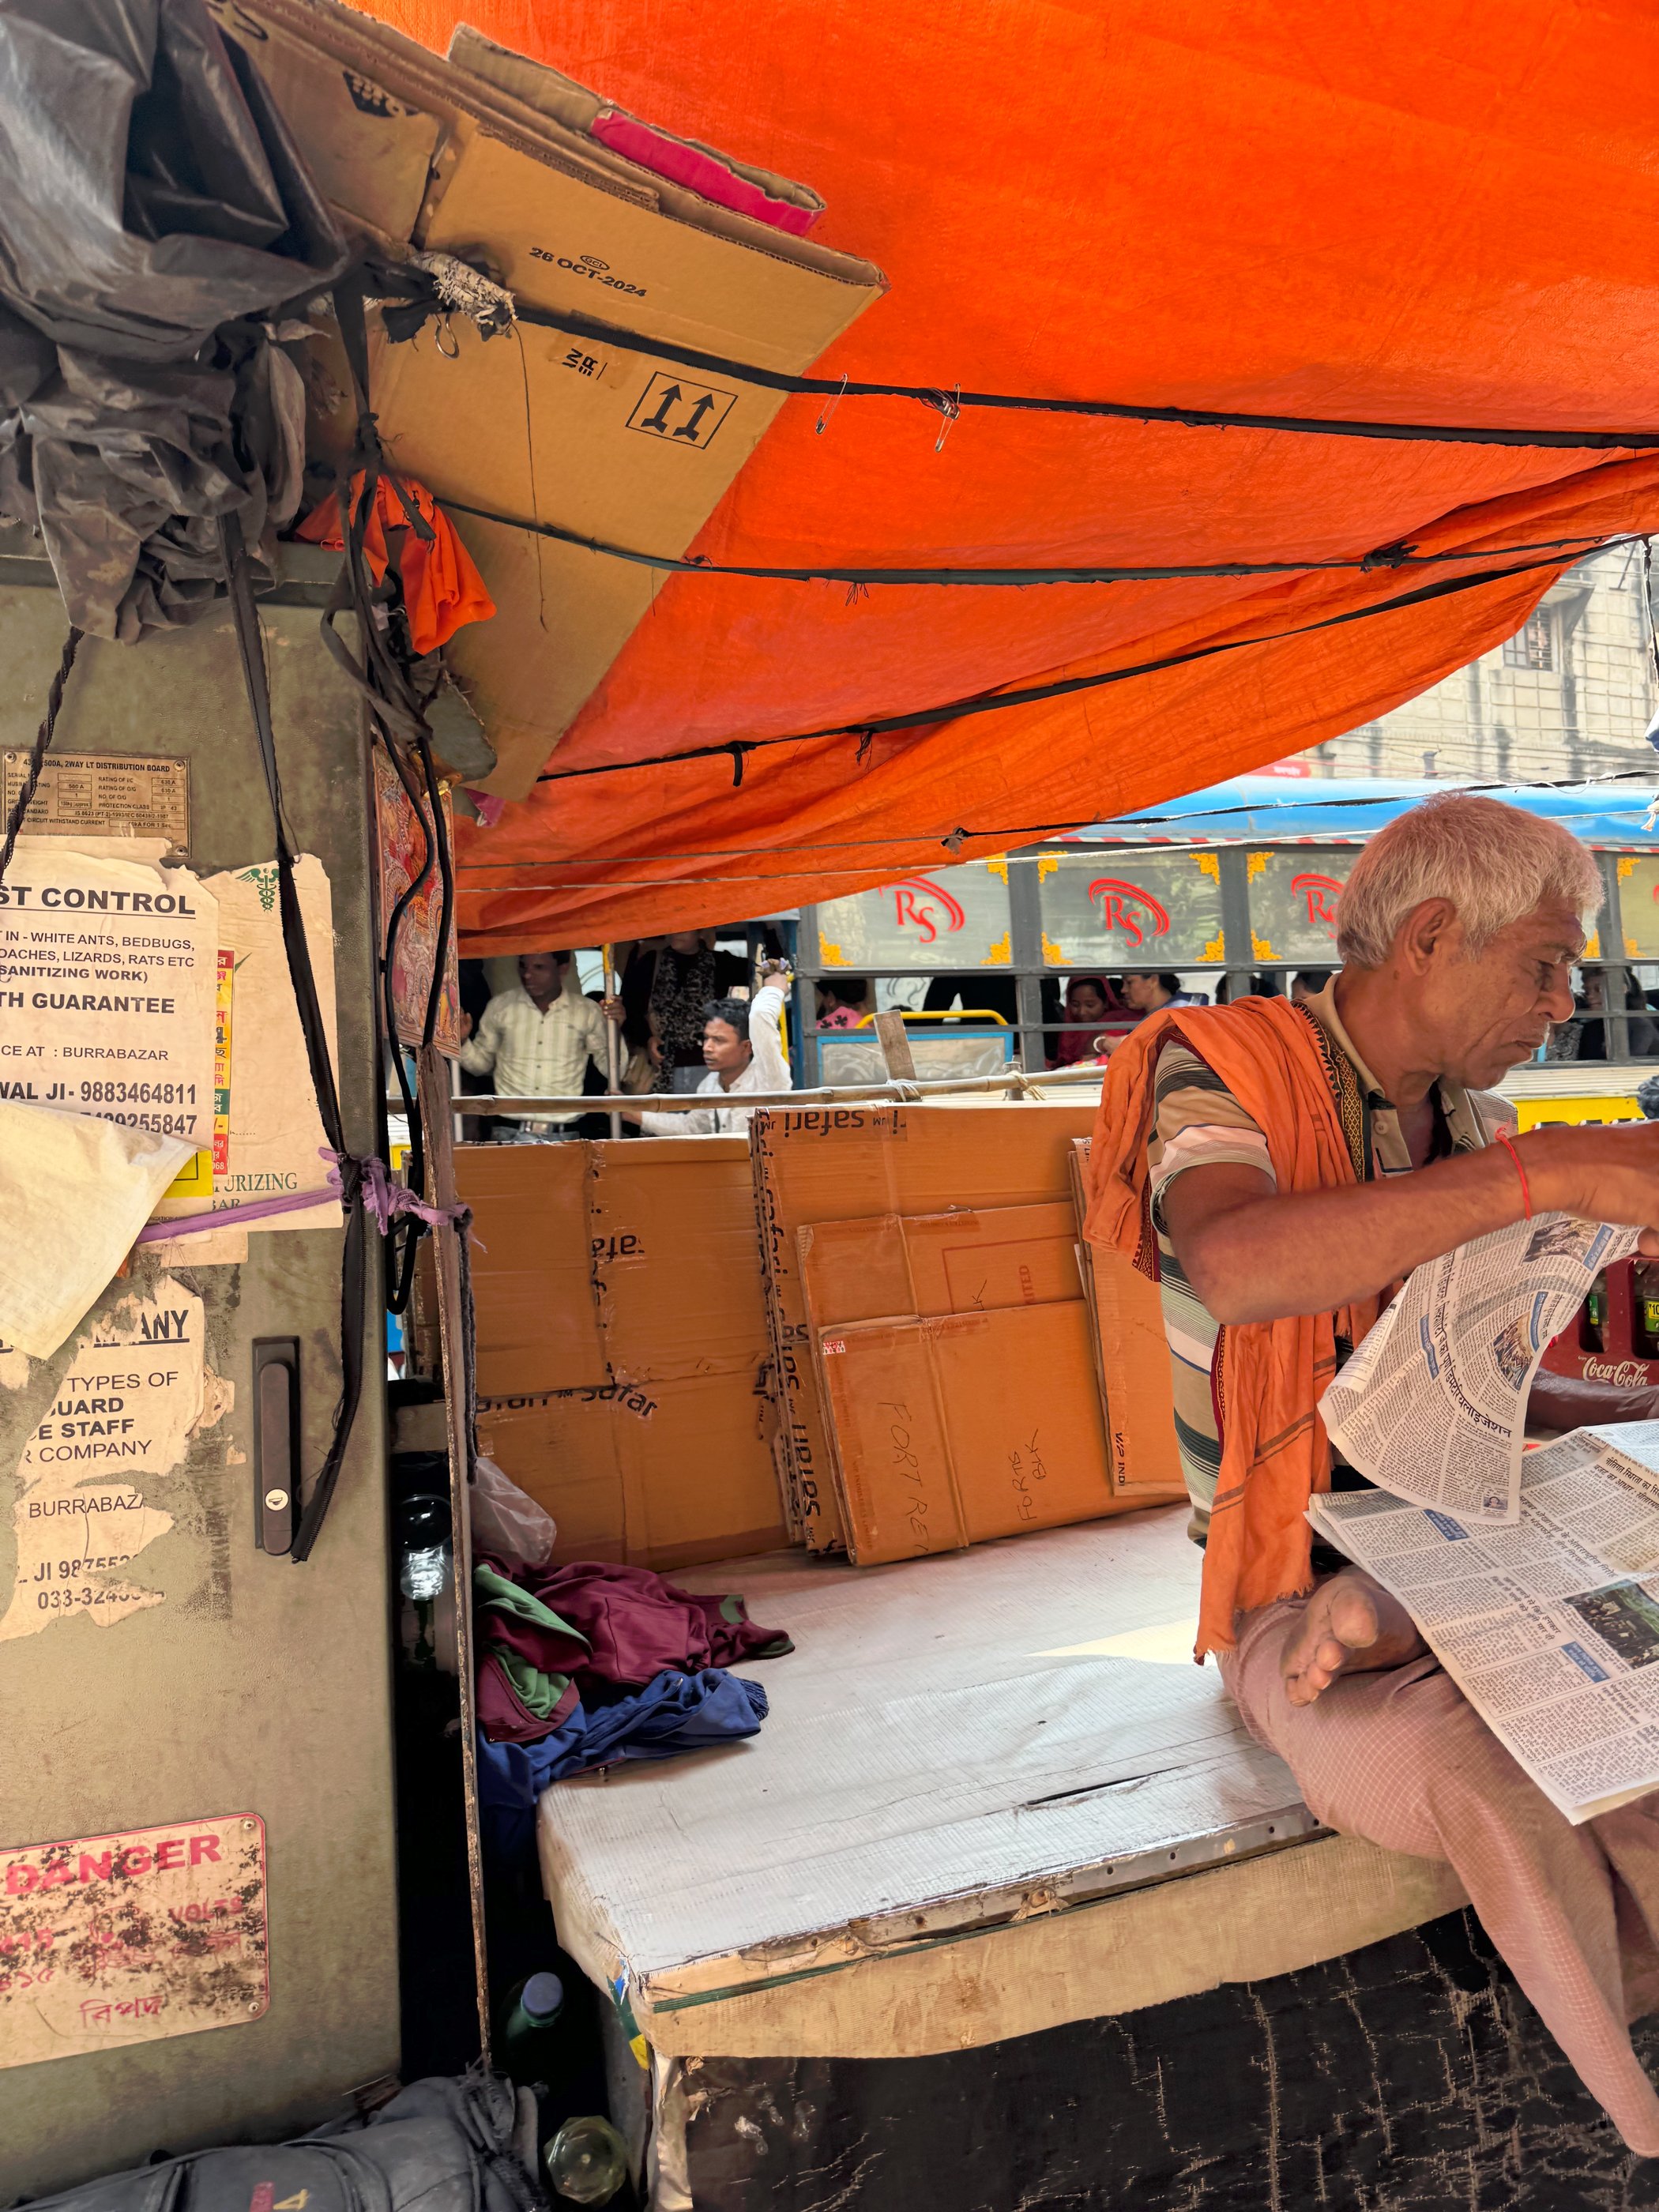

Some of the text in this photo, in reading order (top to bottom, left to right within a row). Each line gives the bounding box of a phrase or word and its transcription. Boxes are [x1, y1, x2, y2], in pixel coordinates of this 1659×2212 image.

[529, 246, 648, 298] 26 OCT-2024
[96, 762, 145, 772] DISTRIBUTION
[41, 887, 196, 915] CONTROL
[6, 931, 19, 941] IN
[31, 932, 75, 944] WHITE
[77, 934, 118, 947] ANTS,
[122, 936, 195, 951] BEDBUGS,
[63, 951, 125, 965] LIZARDS,
[129, 954, 164, 965] RATS
[168, 957, 194, 968] ETC
[95, 969, 149, 984] WORK)
[32, 992, 175, 1014] GUARANTEE
[1, 1045, 22, 1056] CE
[26, 1046, 45, 1057] AT
[63, 1047, 169, 1061] BURRABAZAR
[81, 1081, 197, 1104] 9883464811
[784, 1109, 865, 1138] safari
[66, 1371, 179, 1393] TYPES OF
[61, 1418, 134, 1438] STAFF
[40, 1439, 152, 1462] COMPANY
[6, 1834, 222, 1895] DANGER
